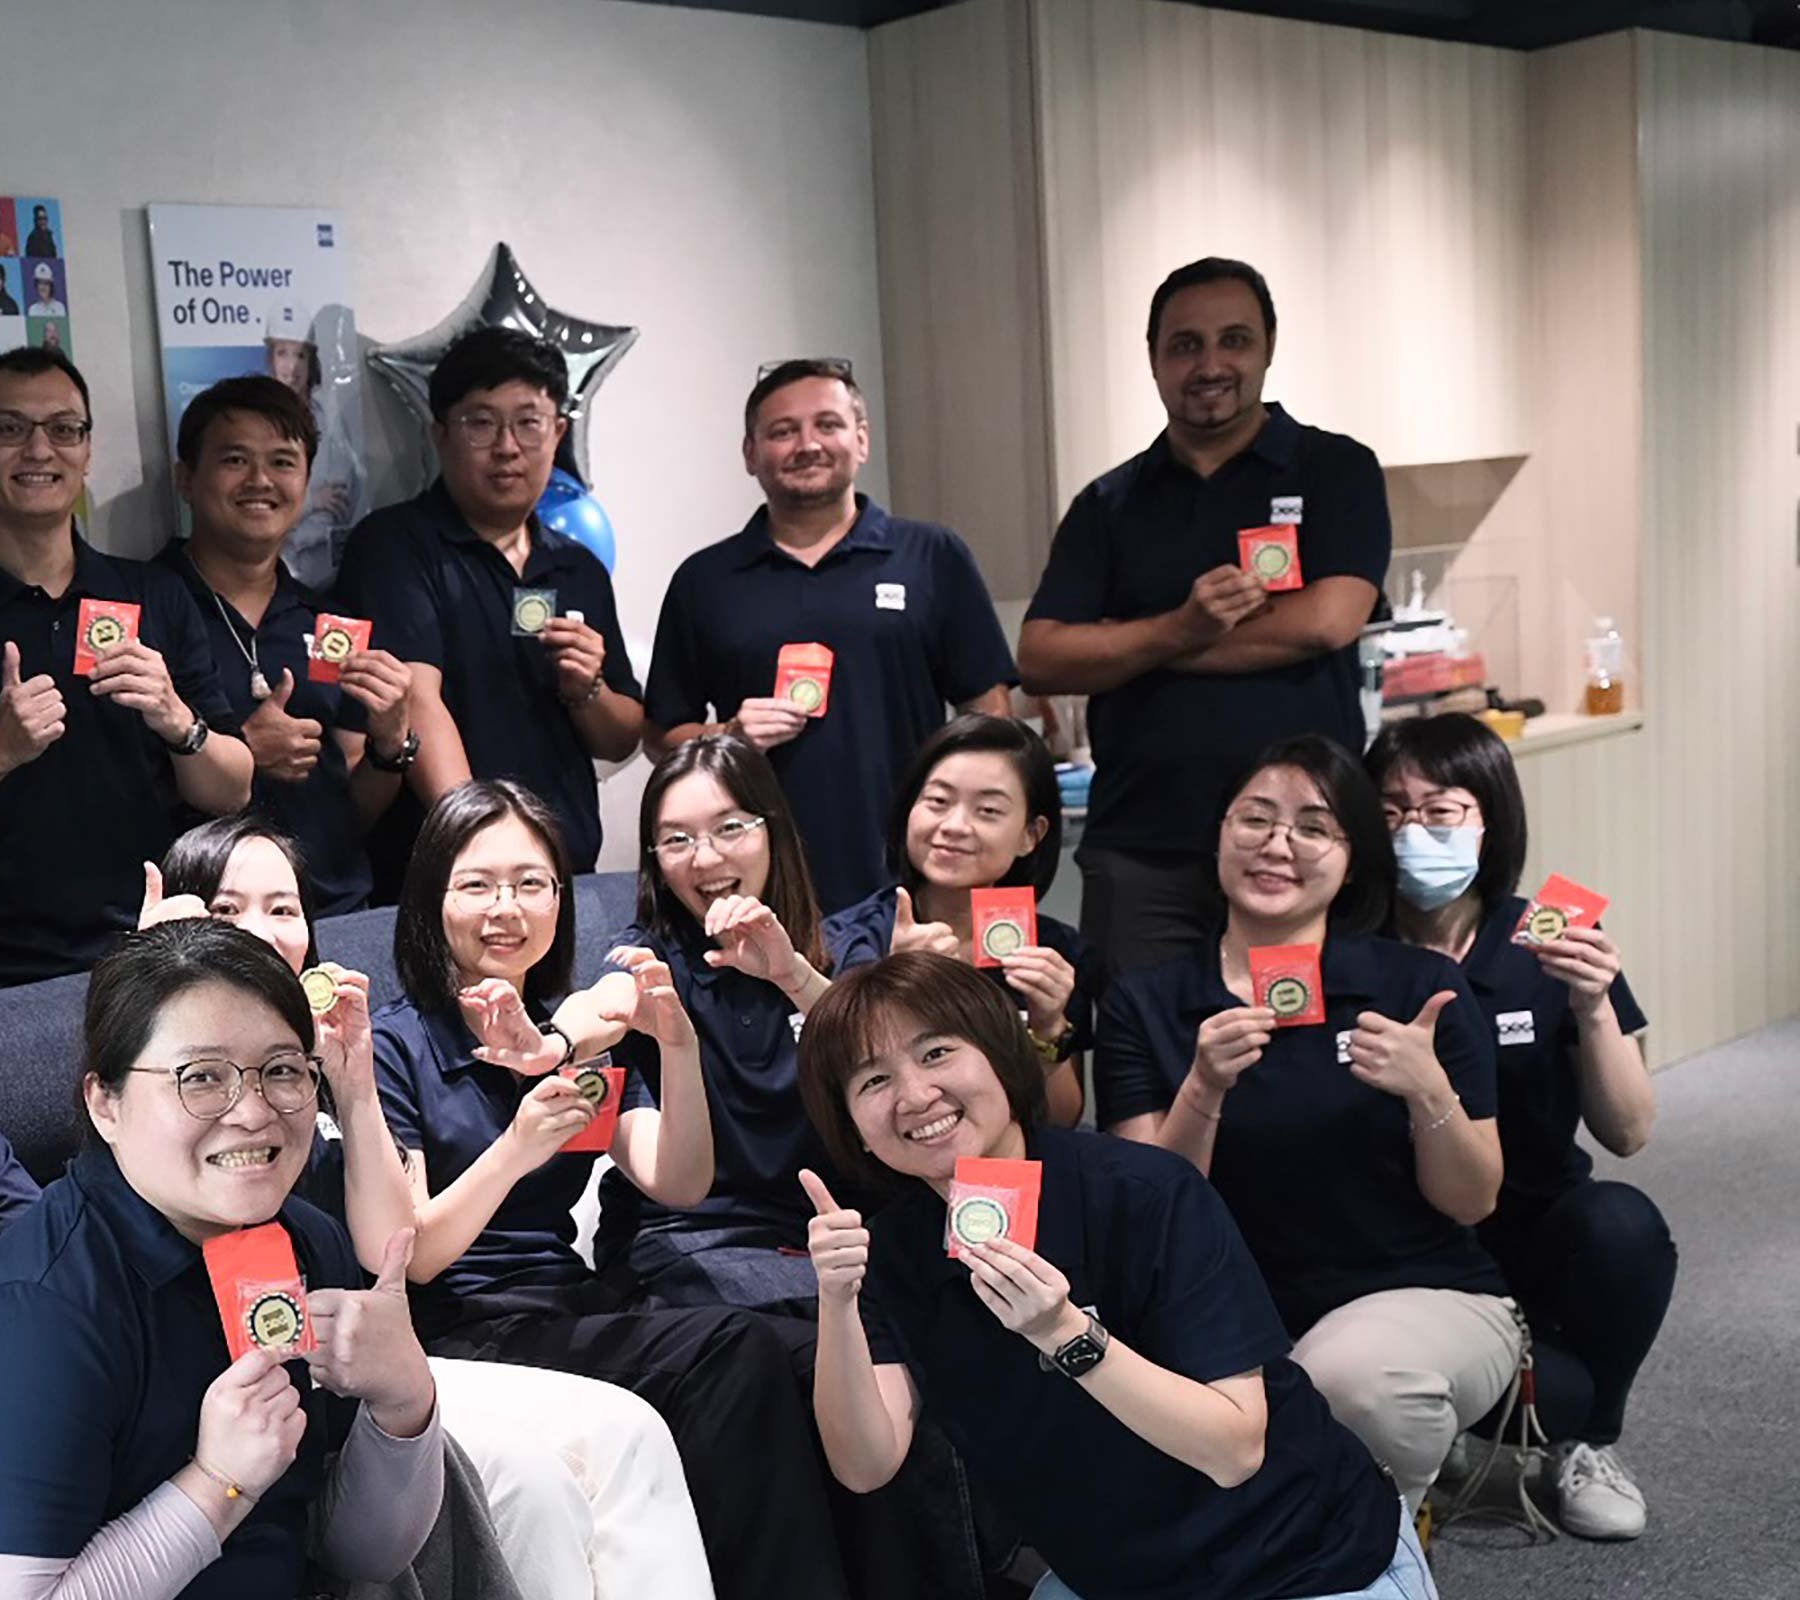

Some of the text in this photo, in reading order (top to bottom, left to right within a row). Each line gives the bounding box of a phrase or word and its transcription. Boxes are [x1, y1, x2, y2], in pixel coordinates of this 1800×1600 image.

[168, 260, 293, 288] The Power
[173, 297, 196, 324] of
[202, 297, 249, 324] One
